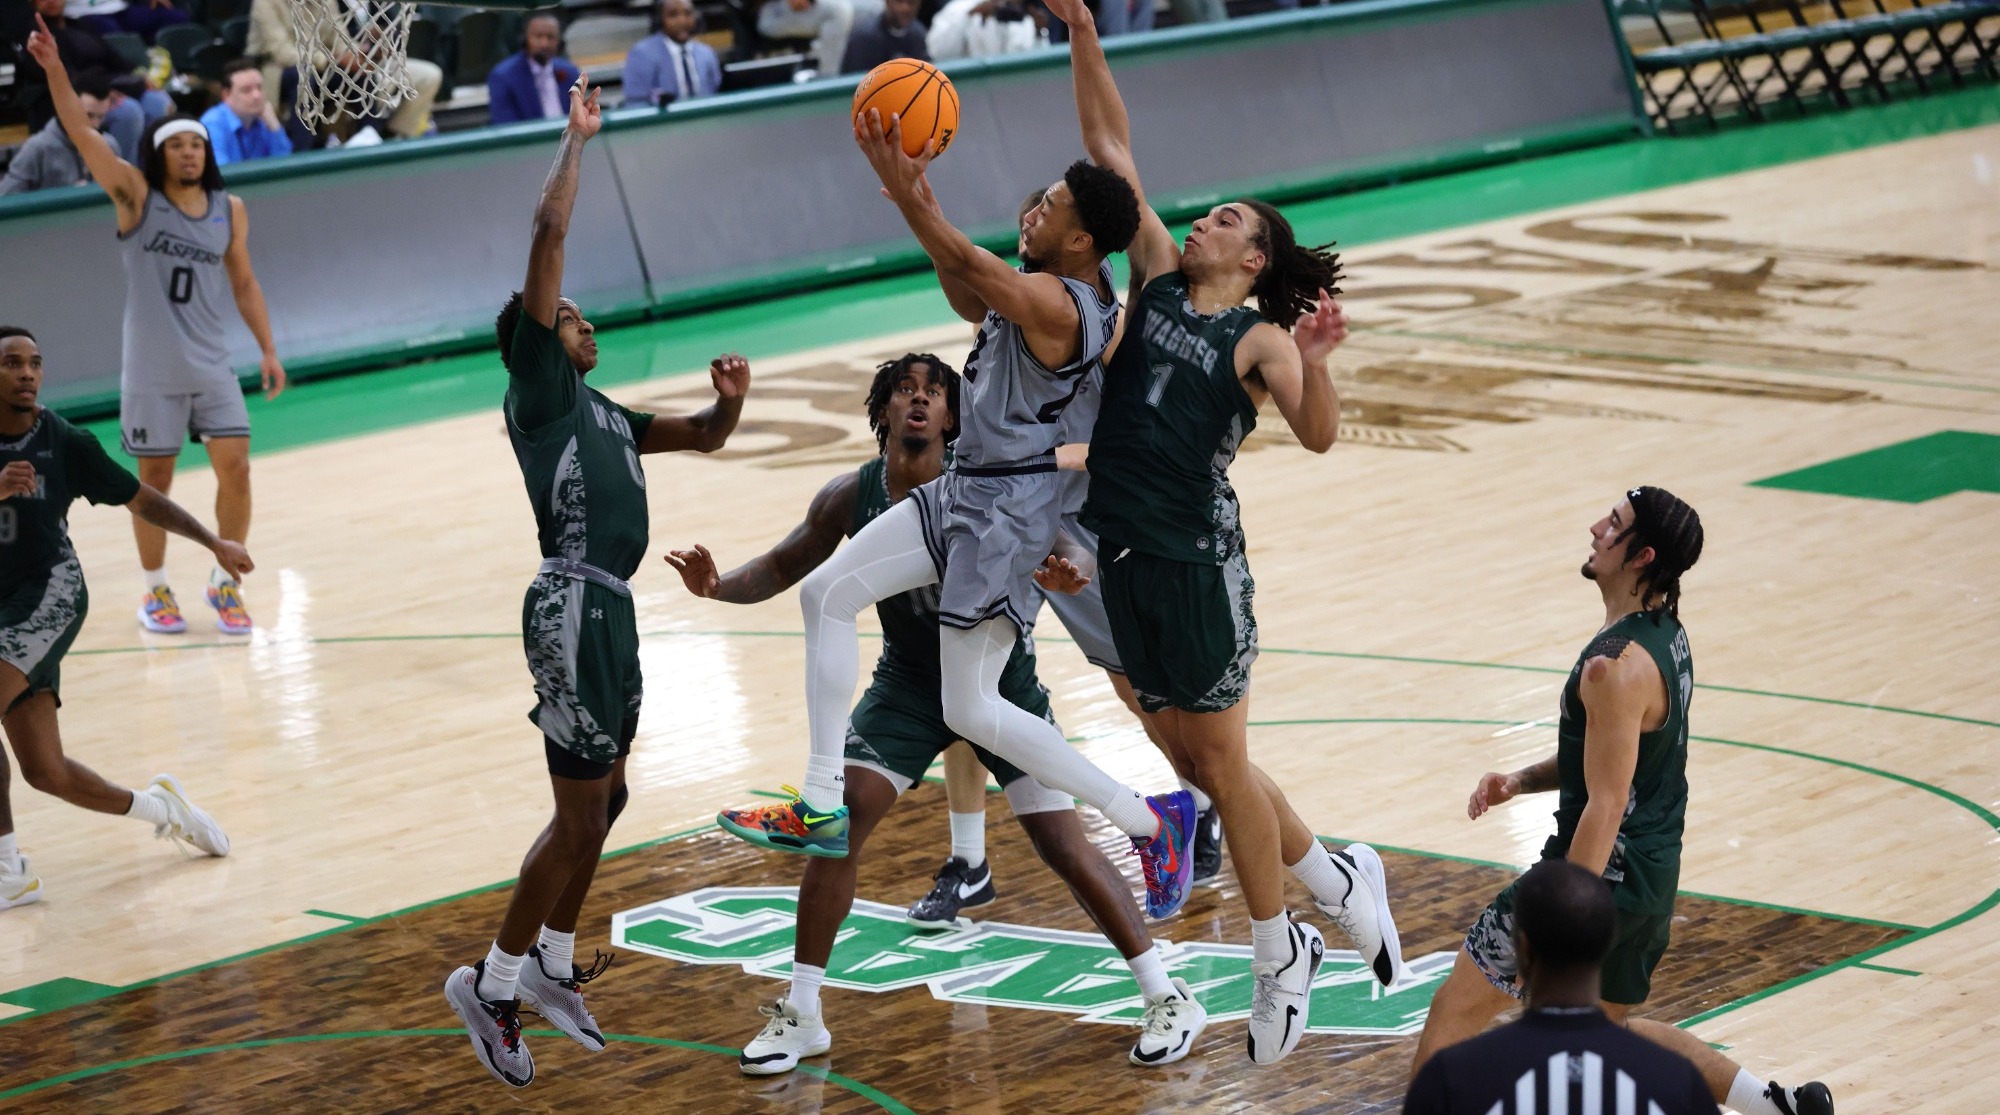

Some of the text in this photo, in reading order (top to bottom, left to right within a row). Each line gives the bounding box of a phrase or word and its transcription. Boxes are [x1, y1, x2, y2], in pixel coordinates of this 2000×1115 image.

[143, 230, 223, 265] JASPERS
[169, 266, 194, 304] 0
[1142, 308, 1218, 376] WAGNER
[1145, 362, 1175, 408] 1
[132, 428, 148, 444] M
